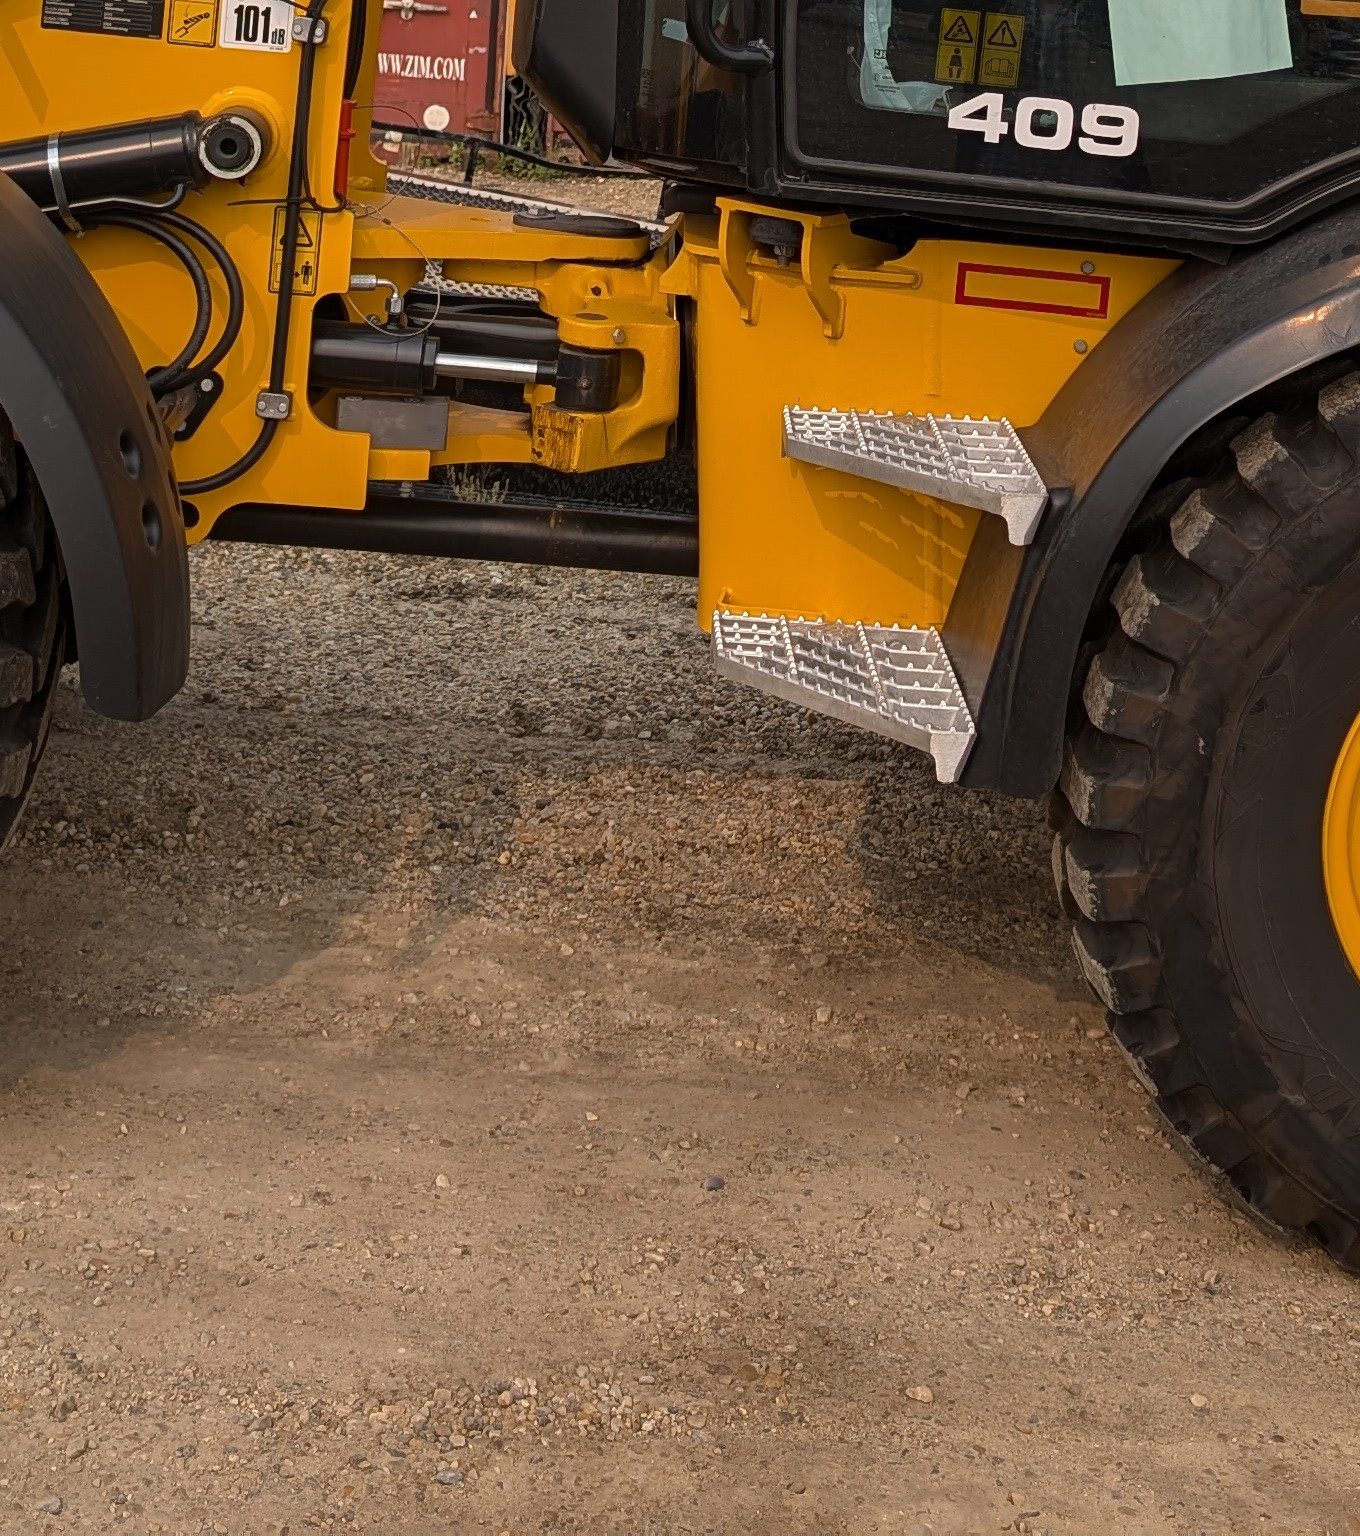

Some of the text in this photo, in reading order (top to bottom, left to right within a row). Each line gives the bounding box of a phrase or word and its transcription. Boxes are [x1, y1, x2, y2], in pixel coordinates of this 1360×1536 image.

[234, 4, 286, 45] 101 dB
[948, 92, 1139, 157] 409
